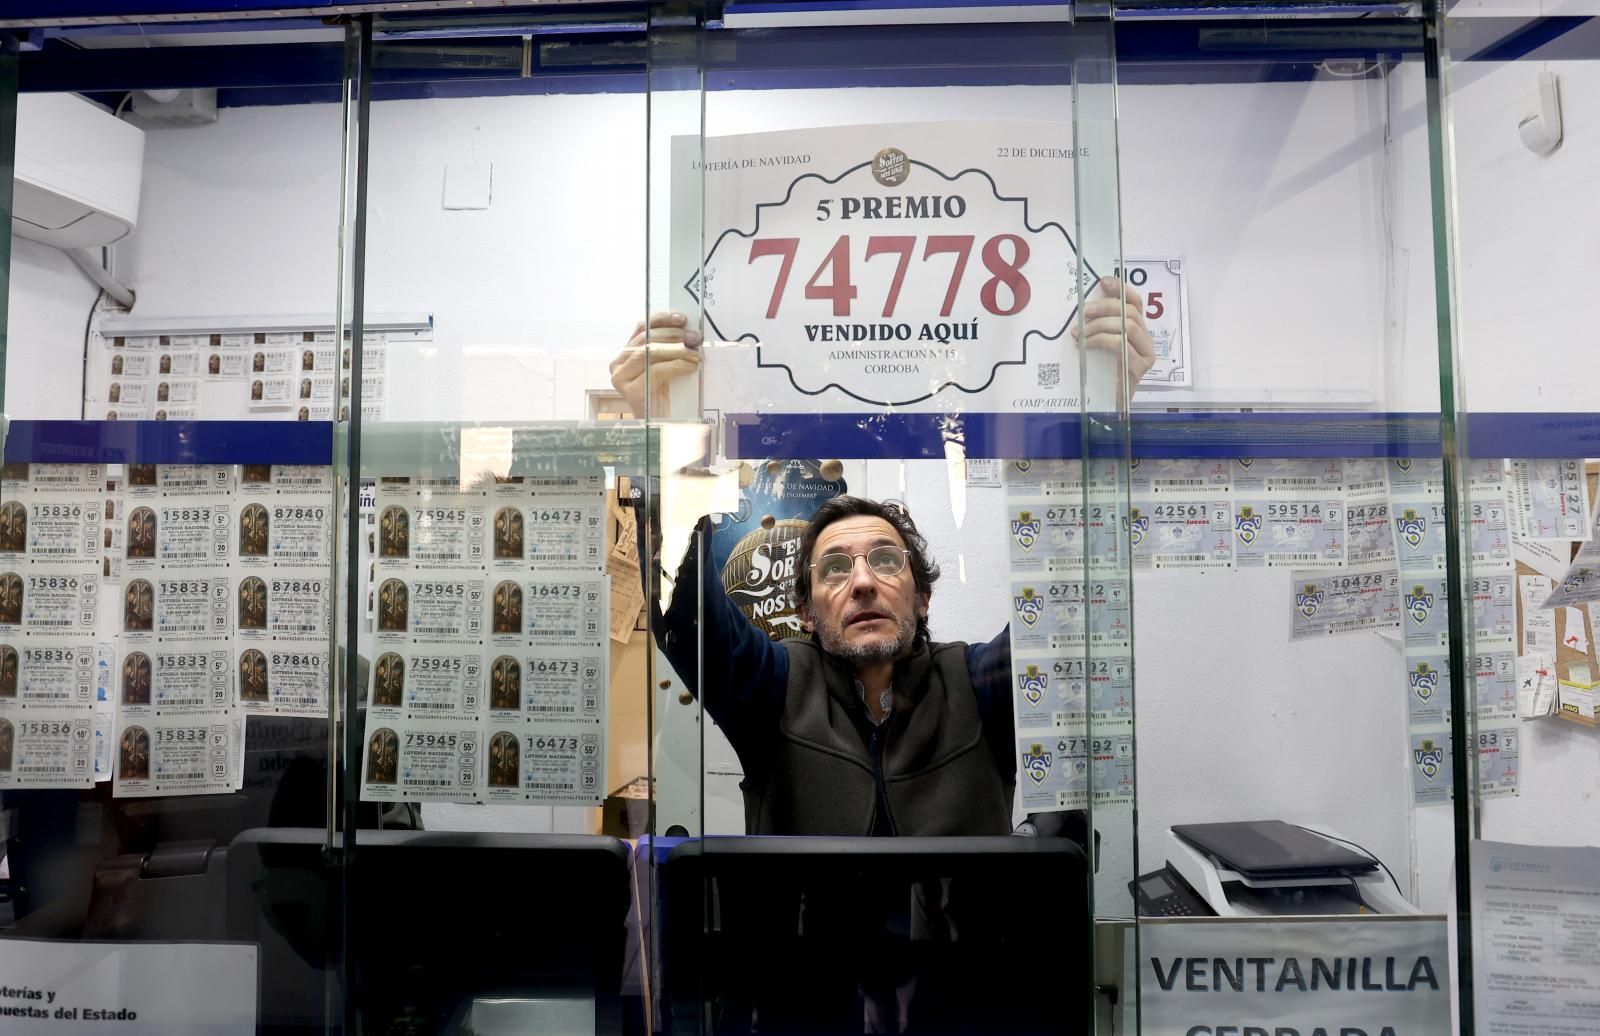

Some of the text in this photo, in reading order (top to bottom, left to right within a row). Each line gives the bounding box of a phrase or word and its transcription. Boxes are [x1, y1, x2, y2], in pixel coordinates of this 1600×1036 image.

[998, 147, 1008, 158] 22
[1012, 148, 1026, 158] DE
[742, 159, 756, 168] DE
[760, 154, 811, 167] NAVIDAD
[840, 194, 966, 220] PREMIO
[748, 232, 1031, 320] 74778
[804, 317, 978, 344] VENDIDO AQUÍ
[828, 350, 926, 360] ADMINISTRACION
[944, 349, 955, 358] 15
[864, 364, 920, 374] CORDOBA
[798, 482, 834, 492] NAVIDAD
[33, 506, 80, 516] 15836
[275, 509, 323, 519] 87840
[1155, 505, 1206, 516] 42561
[1268, 504, 1320, 514] 59514
[1347, 506, 1387, 520] 0478
[163, 510, 210, 520] 15833
[416, 510, 465, 521] 75945
[532, 510, 581, 522] 16473
[30, 578, 78, 588] 15836
[273, 582, 321, 592] 87840
[1333, 575, 1382, 588] 10478
[160, 583, 209, 593] 15833
[415, 584, 464, 594] 75945
[531, 586, 581, 596] 16473
[752, 594, 786, 620] NOS
[25, 650, 73, 661] 15836
[159, 656, 206, 666] 15833
[273, 655, 319, 666] 87840
[412, 659, 461, 669] 75945
[529, 661, 579, 672] 16473
[21, 724, 70, 734] 15836
[156, 730, 206, 740] 15833
[406, 735, 456, 746] 75945
[527, 738, 577, 749] 16473
[1058, 740, 1112, 752] 67192
[1151, 956, 1440, 992] VENTANILLA
[0, 986, 56, 1004] terías y
[54, 1006, 77, 1020] del
[83, 1008, 136, 1021] Estado
